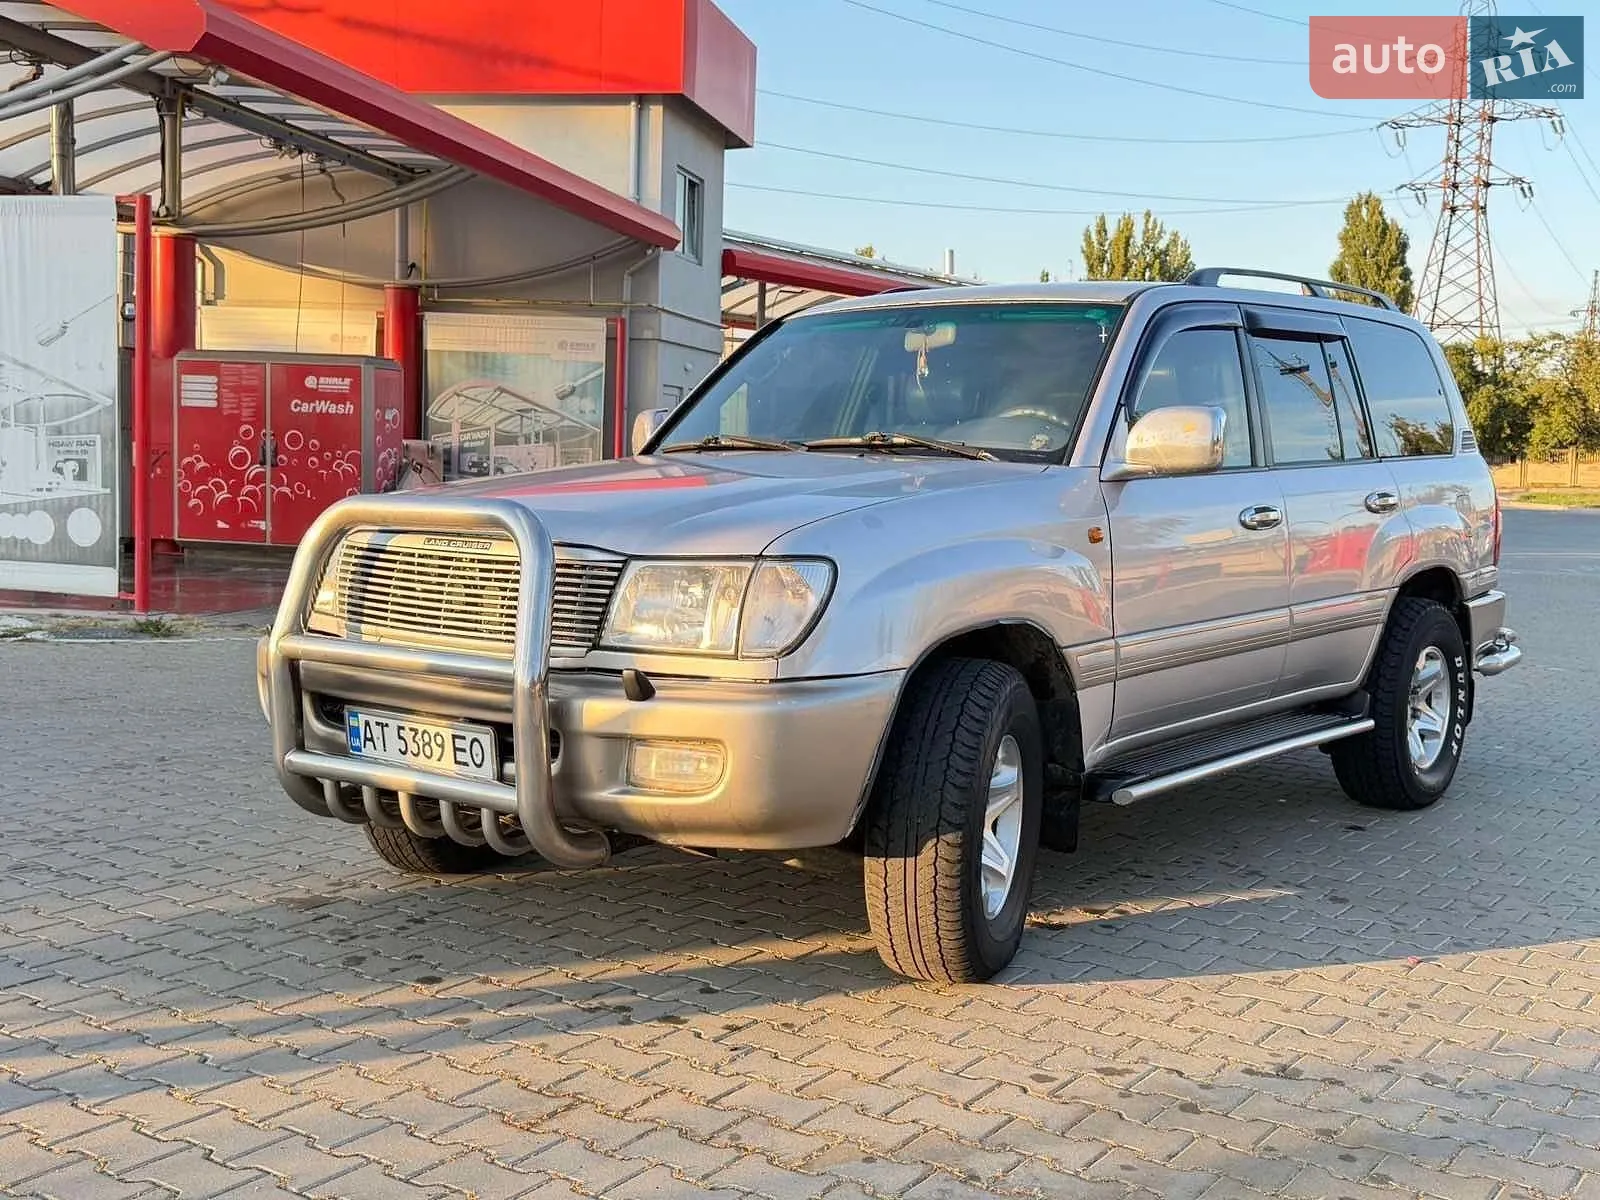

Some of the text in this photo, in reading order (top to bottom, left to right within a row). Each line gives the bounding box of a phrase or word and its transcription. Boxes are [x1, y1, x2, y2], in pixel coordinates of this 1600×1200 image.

[290, 399, 354, 414] CarWash
[425, 538, 491, 549] LAND CRUISER
[1452, 655, 1466, 757] DUNLOP
[351, 737, 361, 747] UA
[363, 719, 389, 752] AT
[397, 725, 445, 761] 5389
